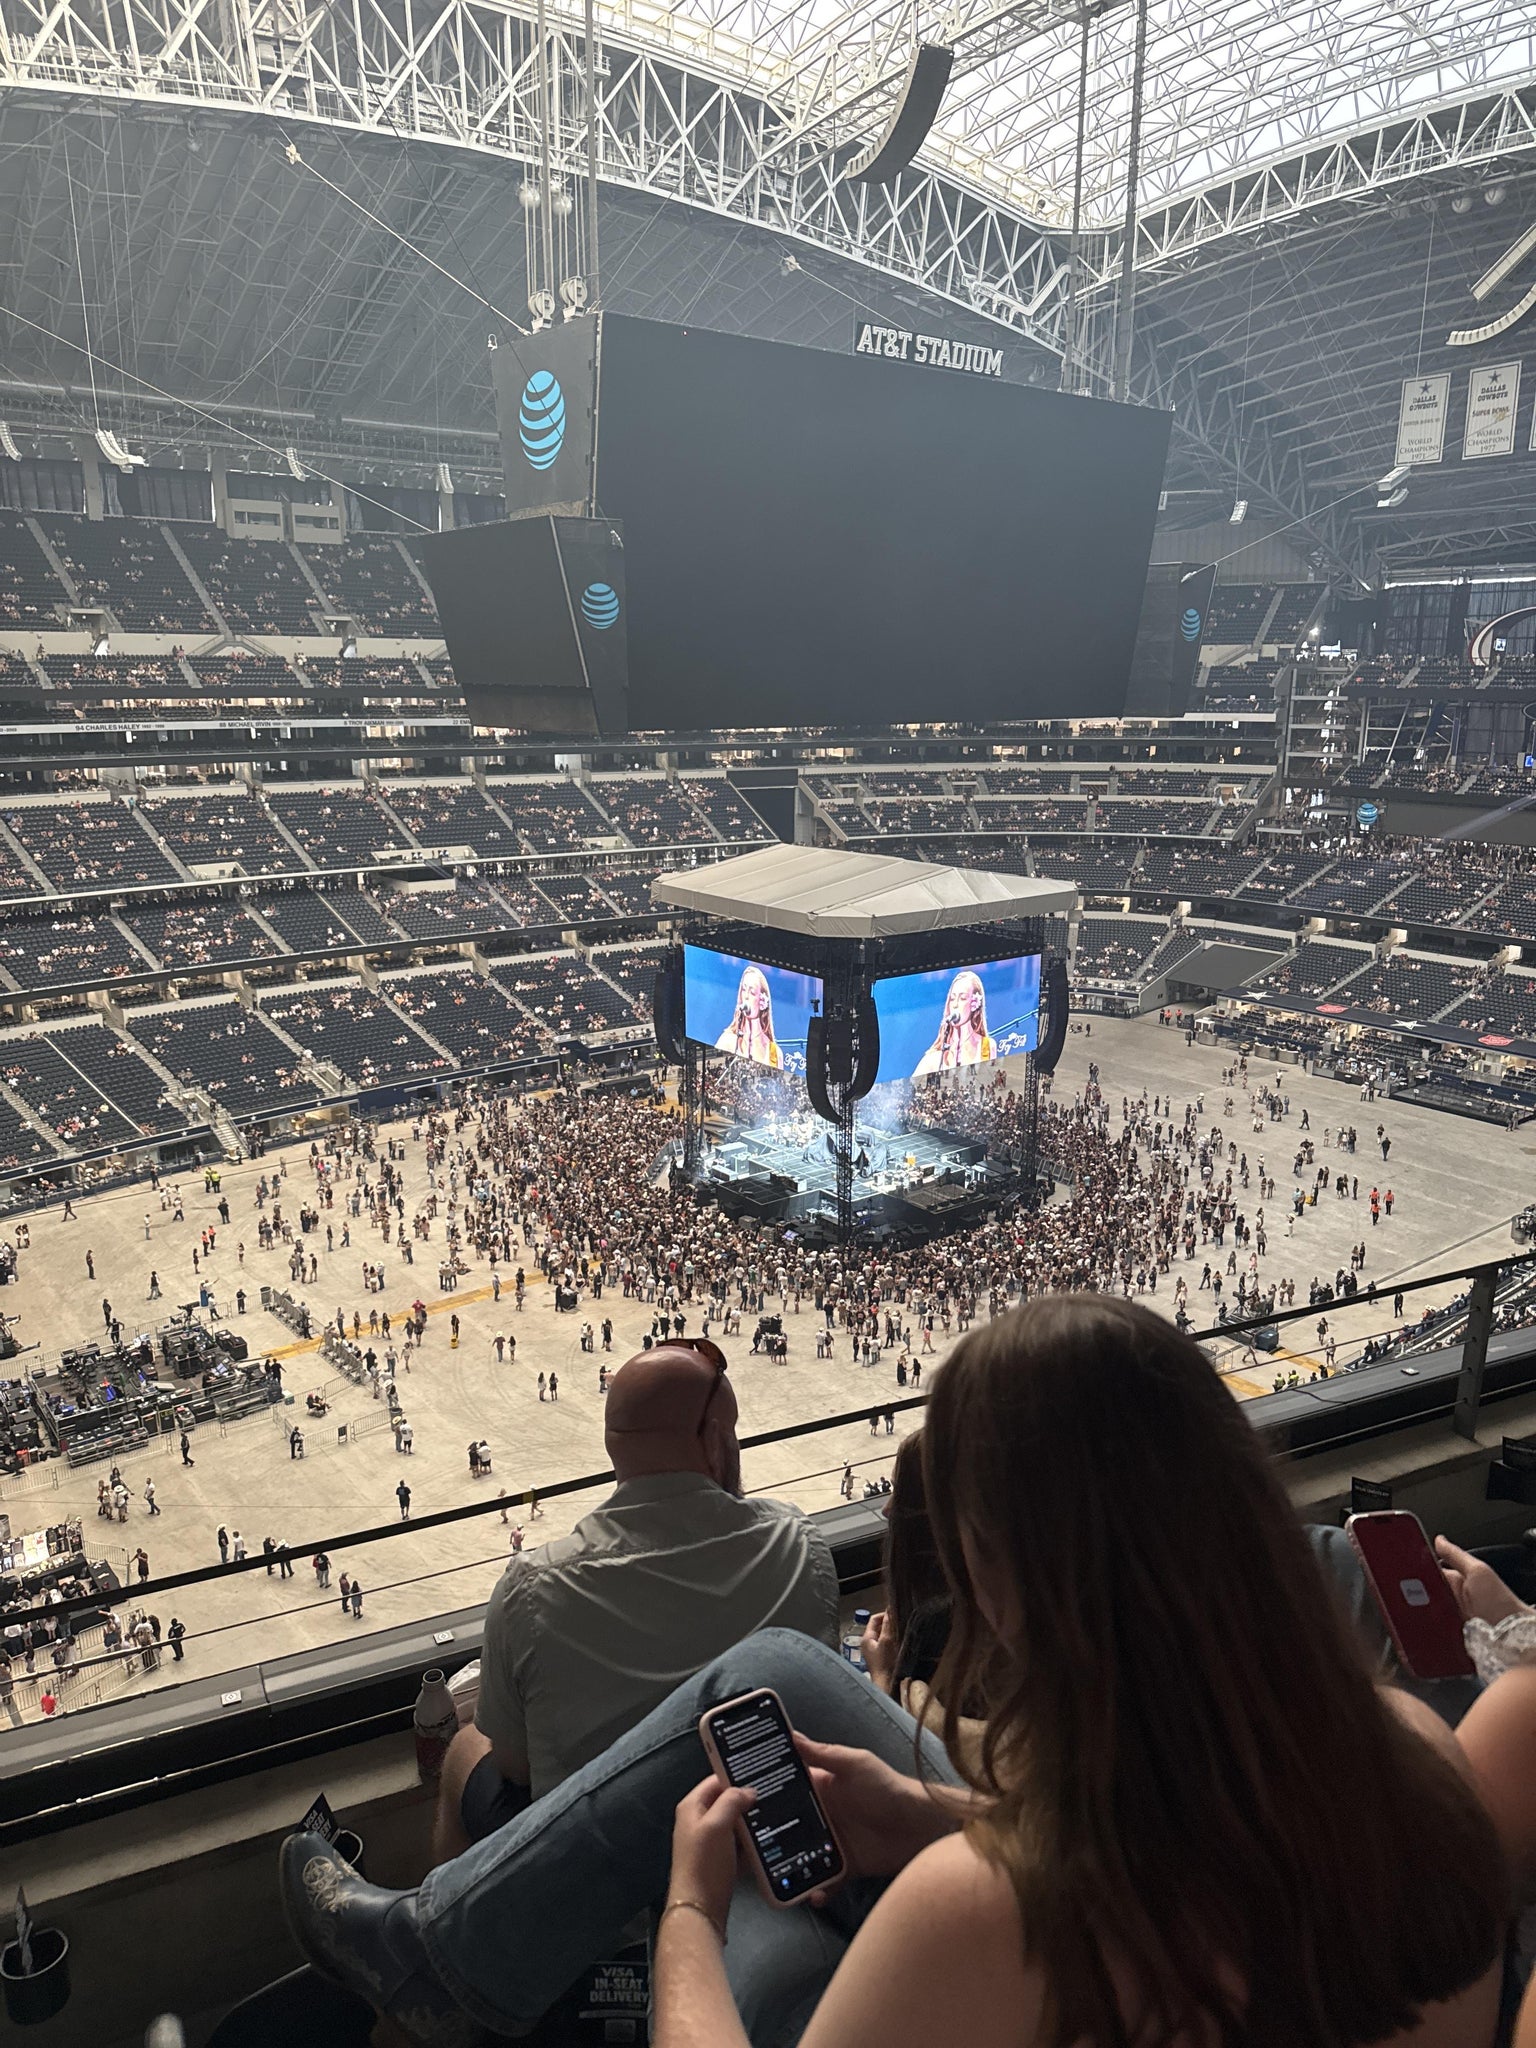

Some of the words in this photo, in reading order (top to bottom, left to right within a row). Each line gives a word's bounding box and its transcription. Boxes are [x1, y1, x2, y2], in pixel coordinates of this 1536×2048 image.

[856, 324, 912, 360] AT&T
[914, 334, 1004, 376] STADIUM
[1481, 385, 1507, 394] DALLAS
[1412, 395, 1437, 403] DALLAS
[85, 723, 117, 731] CHARLES
[601, 1967, 635, 1977] VISA
[594, 1977, 644, 1990] IN-SEAT
[589, 1990, 650, 2003] DELIVERY
